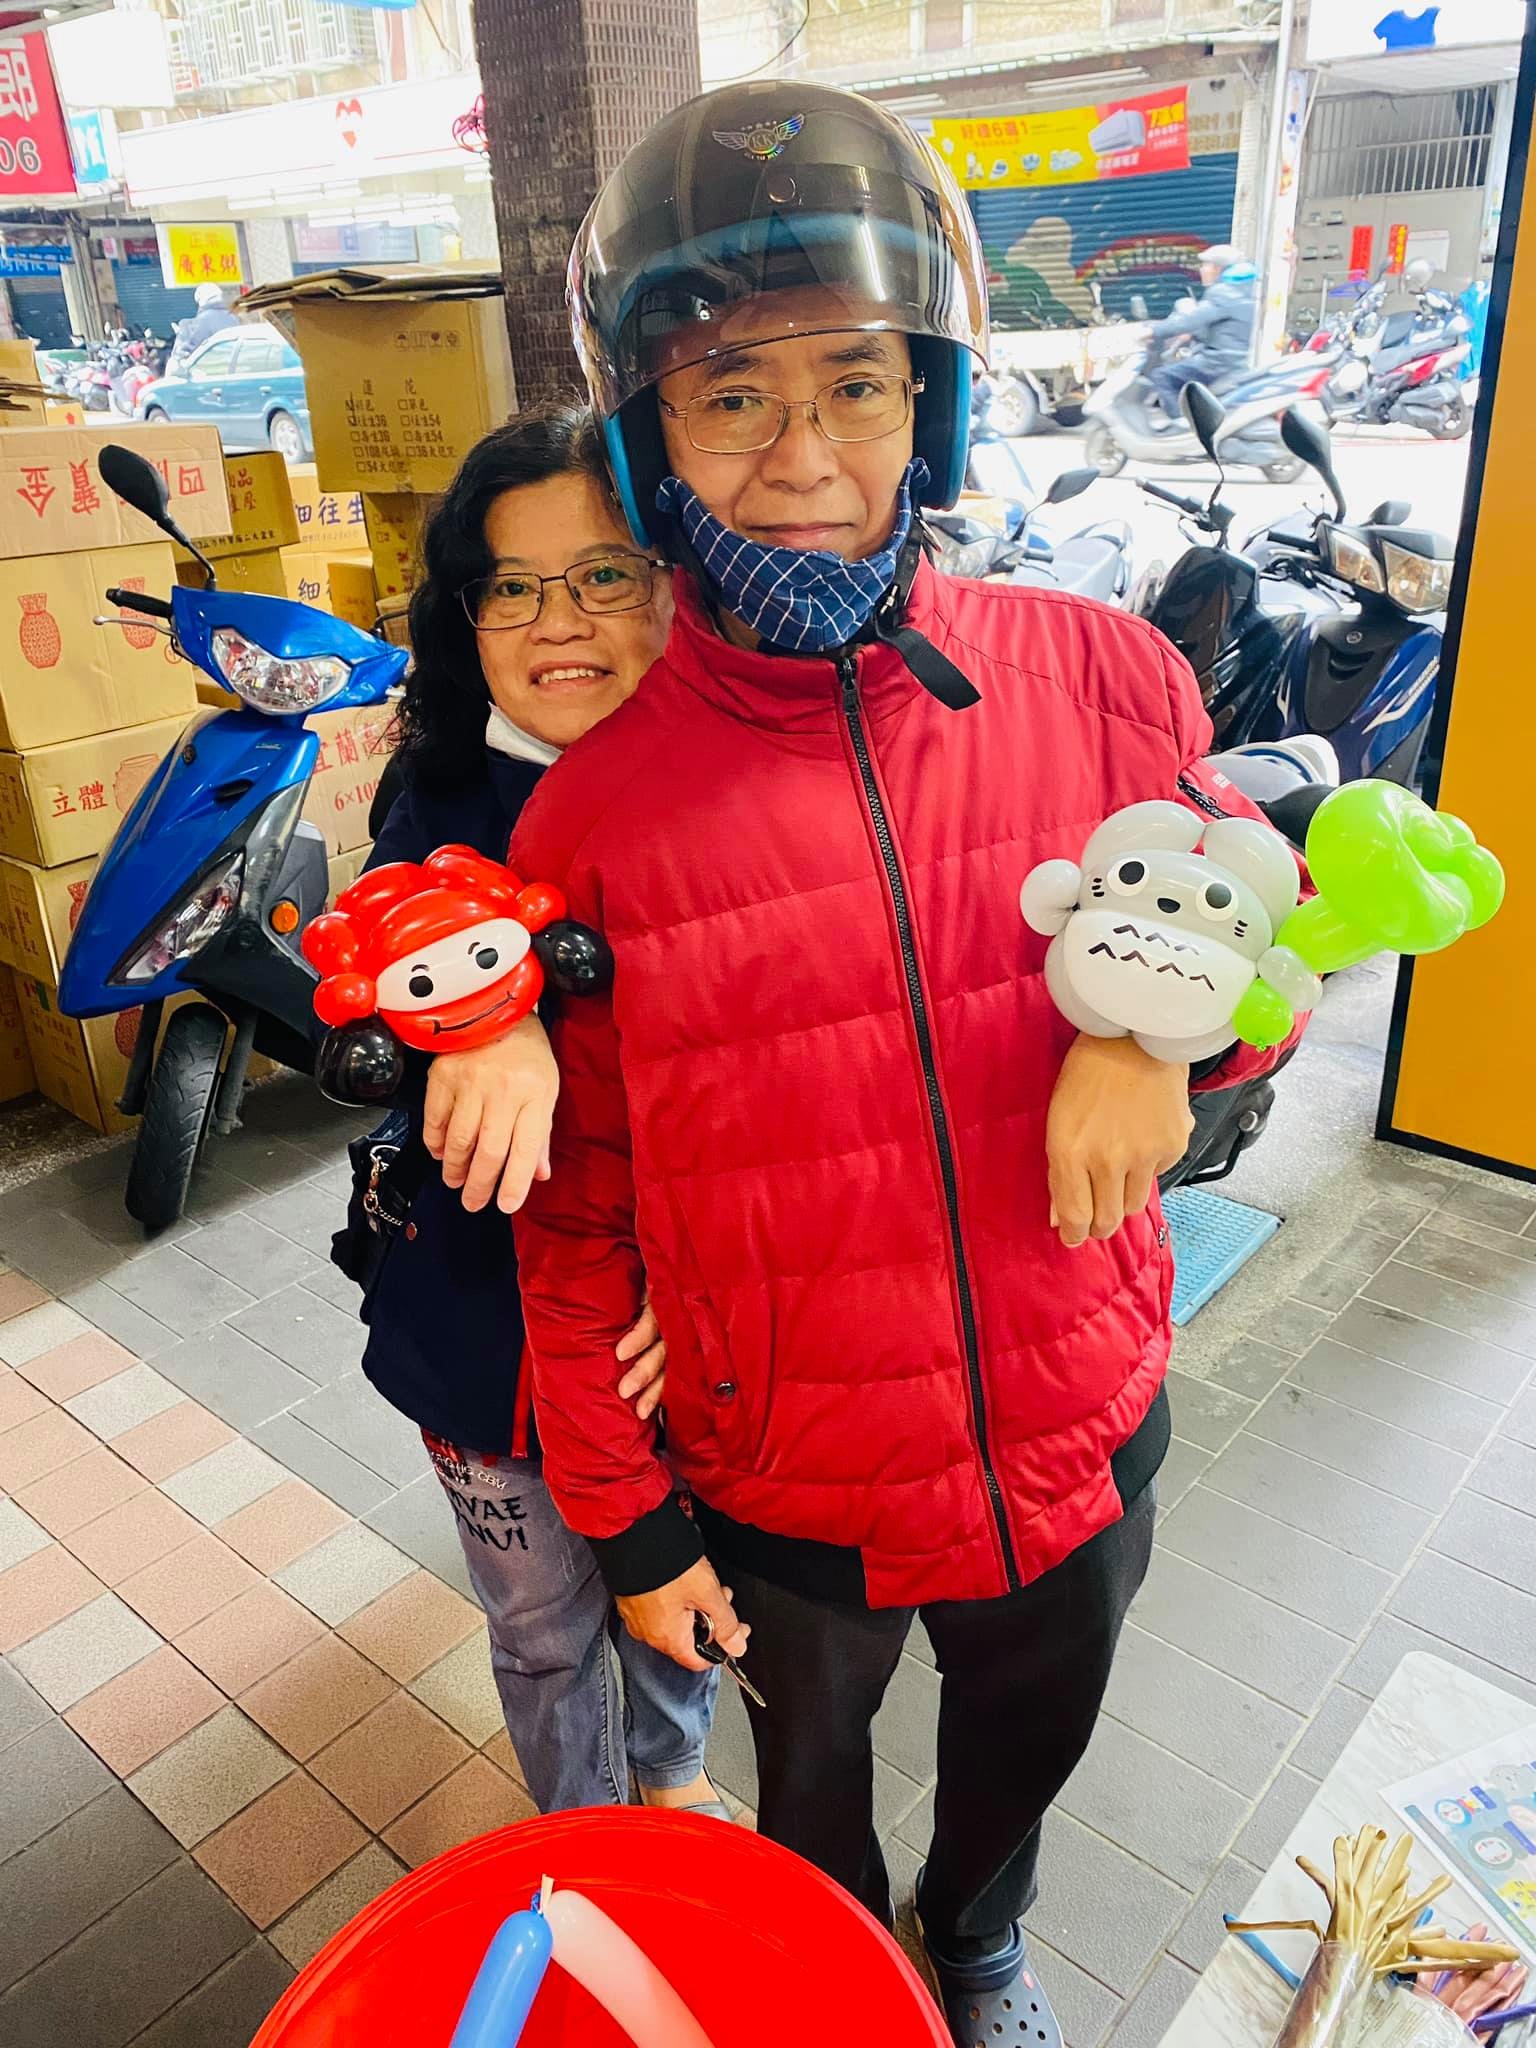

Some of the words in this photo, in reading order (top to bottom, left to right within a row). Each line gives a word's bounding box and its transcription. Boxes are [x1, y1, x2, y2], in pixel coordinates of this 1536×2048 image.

[178, 253, 237, 277] 廣東粥
[51, 780, 108, 818] 立體
